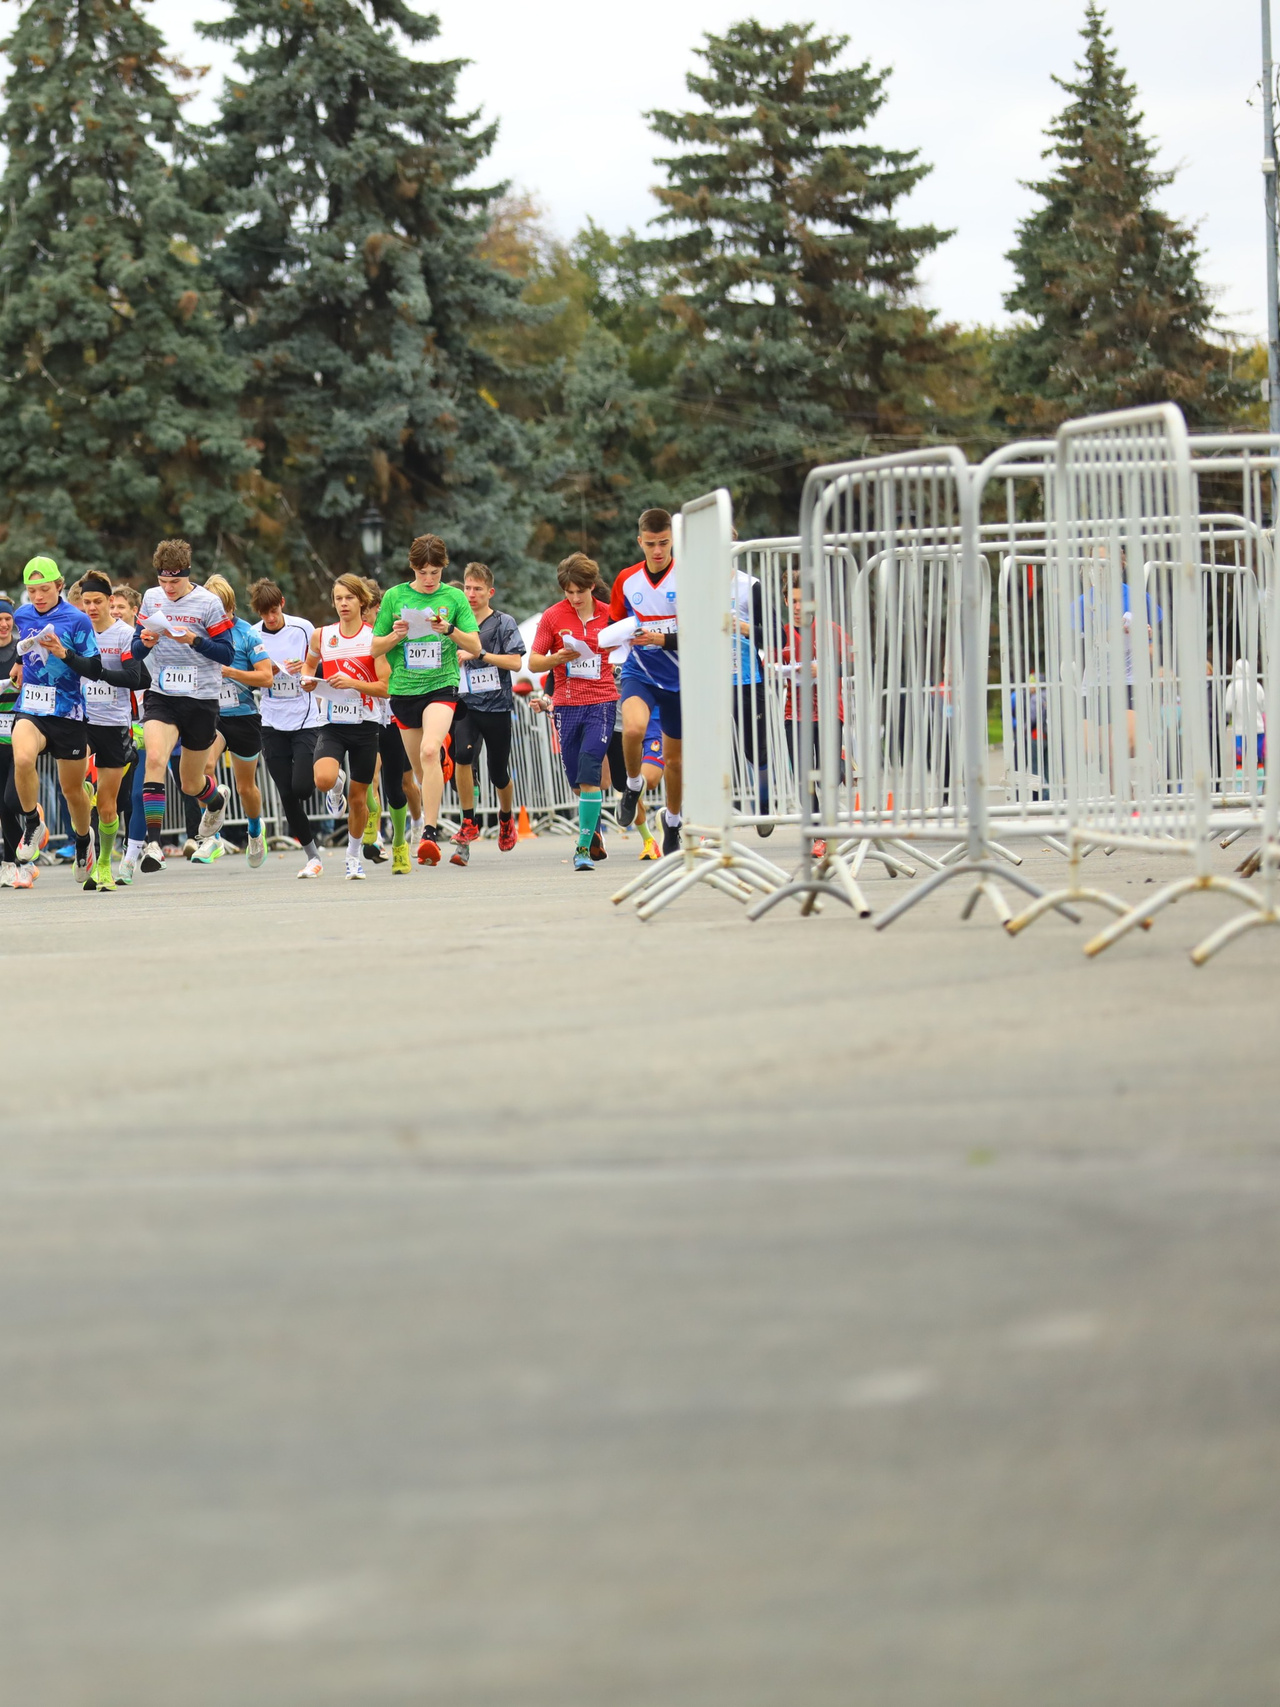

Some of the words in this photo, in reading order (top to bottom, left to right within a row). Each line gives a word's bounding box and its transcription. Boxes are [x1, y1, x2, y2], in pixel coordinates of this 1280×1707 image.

[409, 649, 435, 658] 207.1
[342, 661, 357, 674] Run
[165, 672, 192, 683] 210.1
[471, 673, 494, 684] 212.1
[87, 686, 112, 695] 216.1
[272, 682, 294, 690] 217.1
[25, 689, 49, 702] 219.1
[332, 704, 357, 715] 209.1
